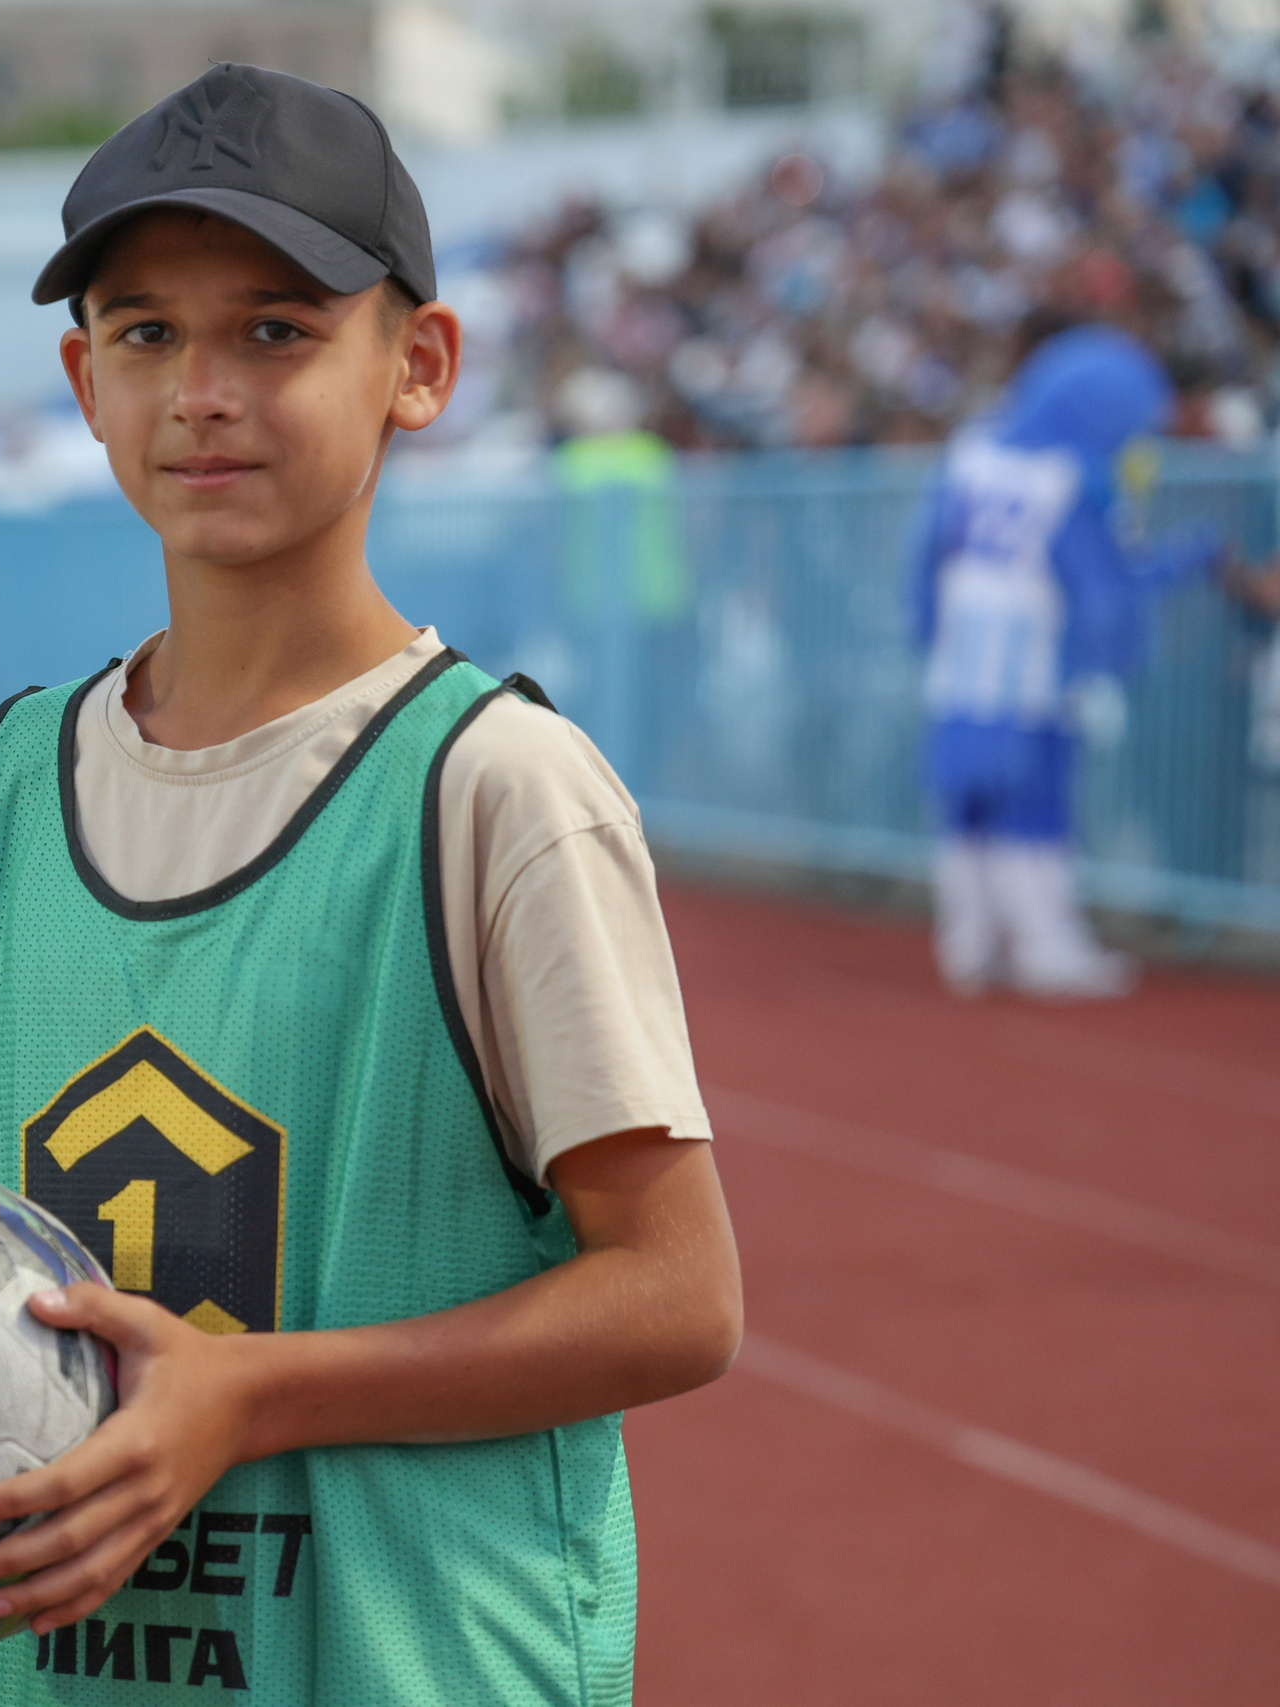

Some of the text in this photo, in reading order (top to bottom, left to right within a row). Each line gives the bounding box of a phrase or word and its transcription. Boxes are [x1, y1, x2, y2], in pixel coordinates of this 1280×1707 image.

[148, 76, 271, 171] NY
[97, 1179, 156, 1291] 1
[122, 1512, 313, 1597] БЕТ
[36, 1619, 250, 1690] ЛИГА
